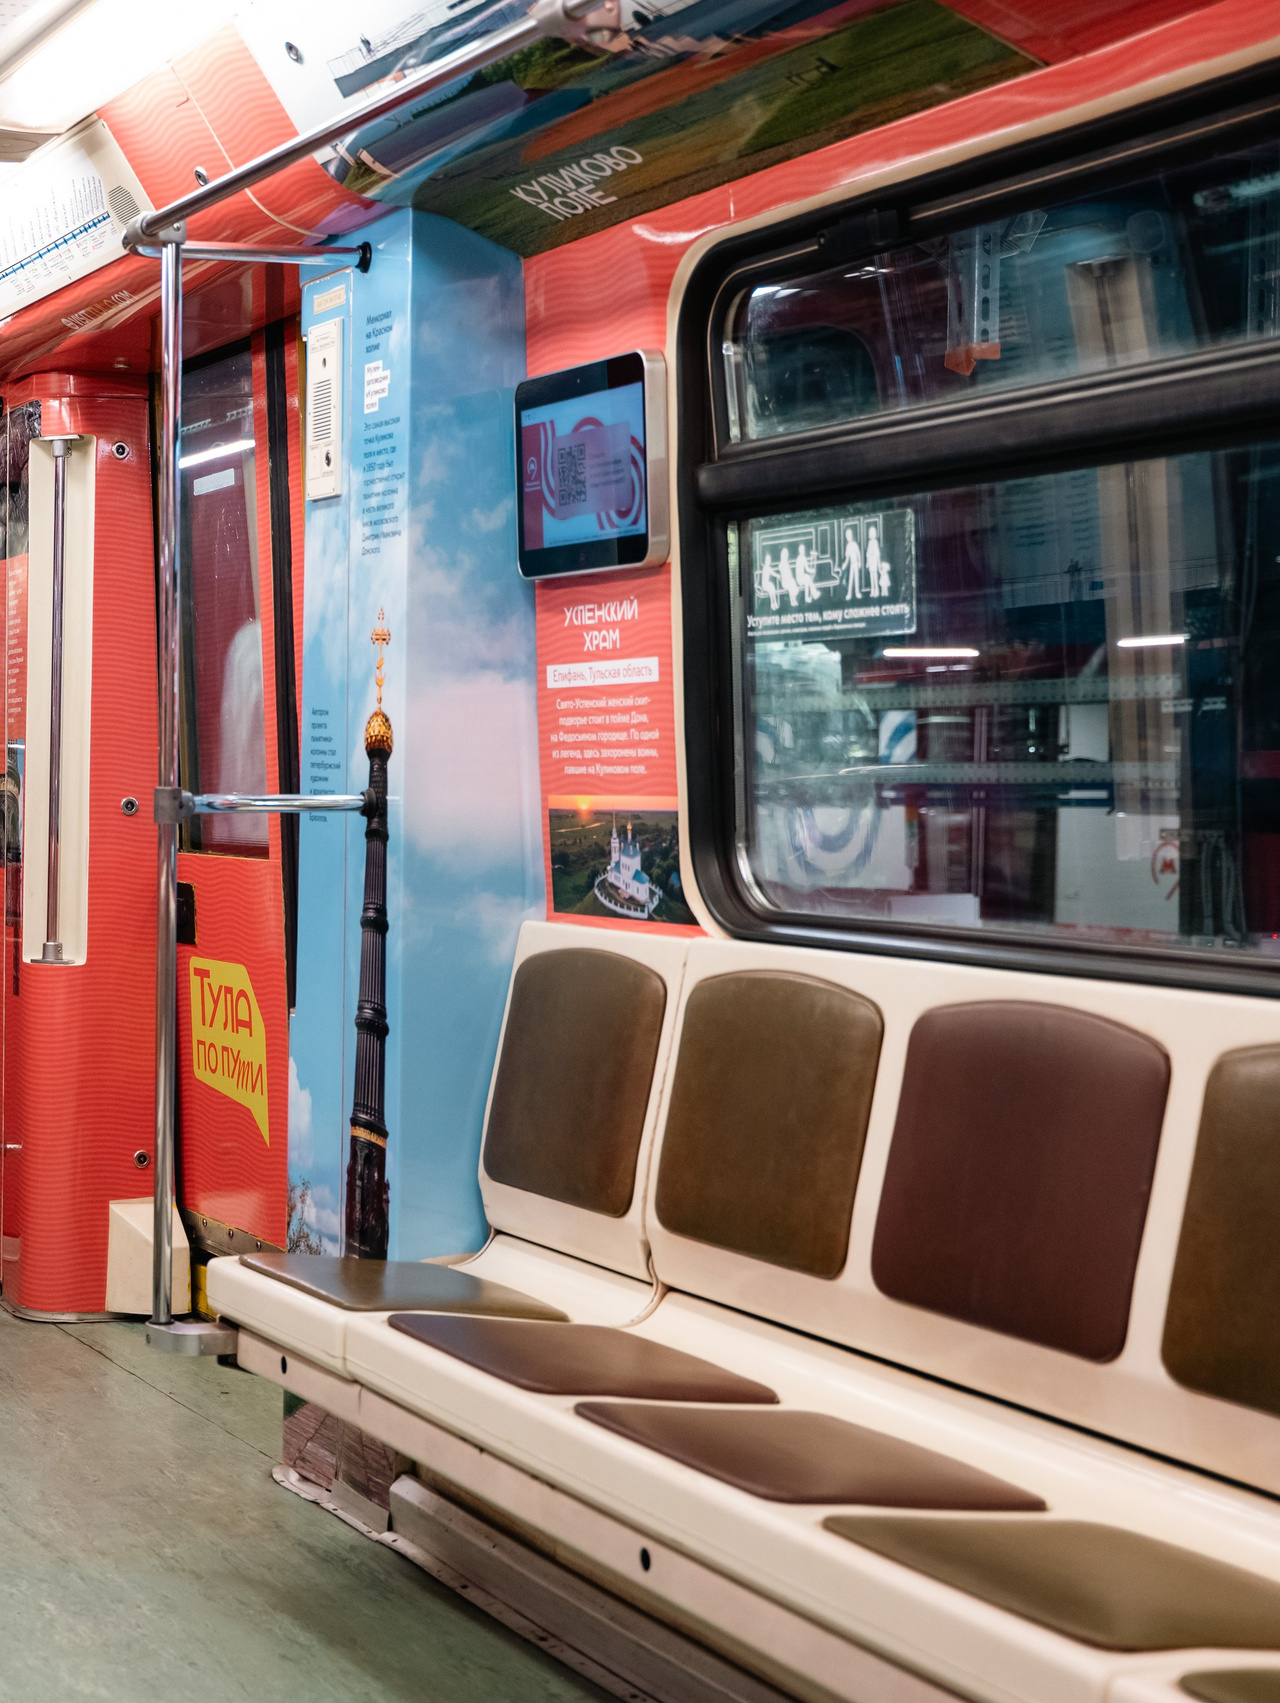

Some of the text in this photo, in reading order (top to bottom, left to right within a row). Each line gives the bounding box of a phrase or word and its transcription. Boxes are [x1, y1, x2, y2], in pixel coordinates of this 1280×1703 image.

[508, 145, 644, 206] КУЛИКОВО
[537, 183, 618, 221] ПОЛЕ
[563, 595, 638, 628] УСПЕНСКИЙ
[747, 603, 910, 629] Уступите место тем, кому сложнее стоять
[583, 629, 620, 652] ХРАМ
[553, 664, 653, 684] Епифань, Тульская область
[558, 715, 587, 727] подворье
[588, 715, 605, 725] стоит
[193, 966, 253, 1038] ТУЛА
[196, 1039, 218, 1075] ПО
